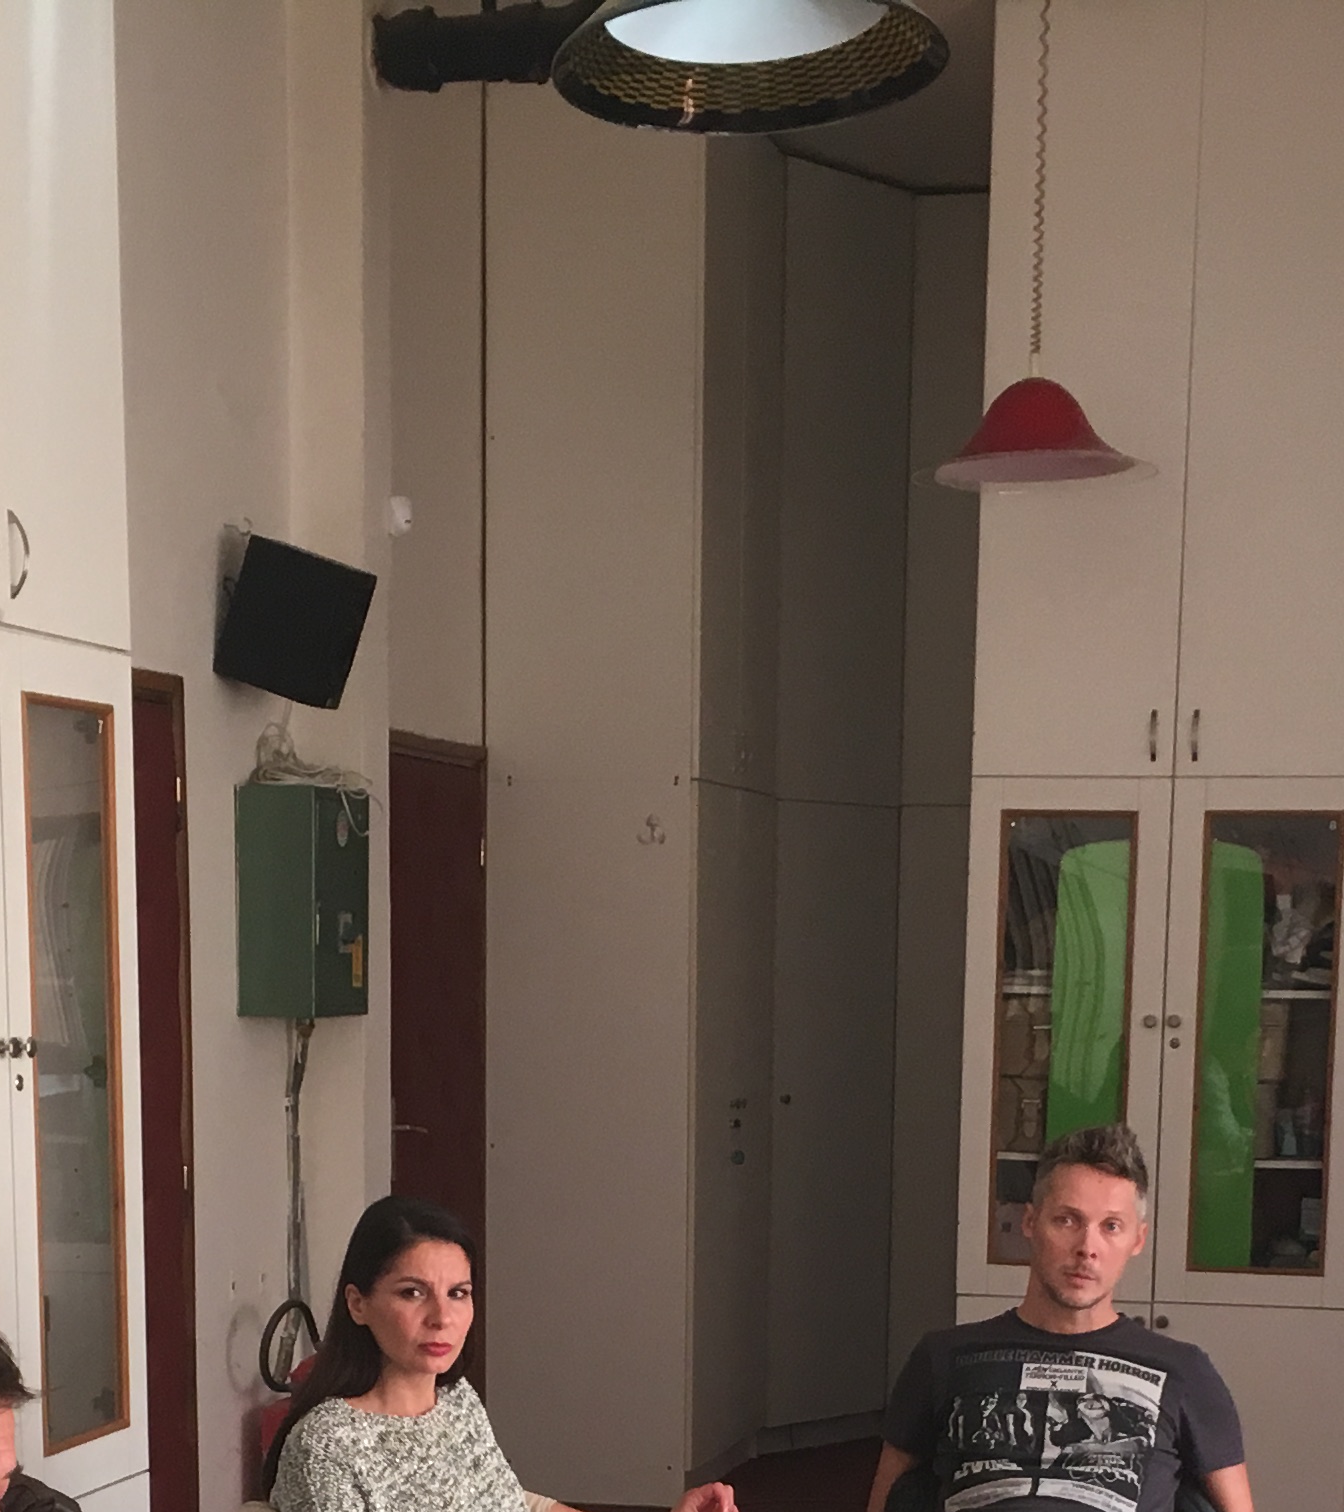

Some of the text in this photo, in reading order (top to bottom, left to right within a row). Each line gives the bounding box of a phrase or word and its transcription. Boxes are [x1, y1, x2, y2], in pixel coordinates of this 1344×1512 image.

[97, 719, 104, 734] 7
[1015, 1349, 1096, 1369] HAMMER
[1098, 1358, 1162, 1386] HORROR
